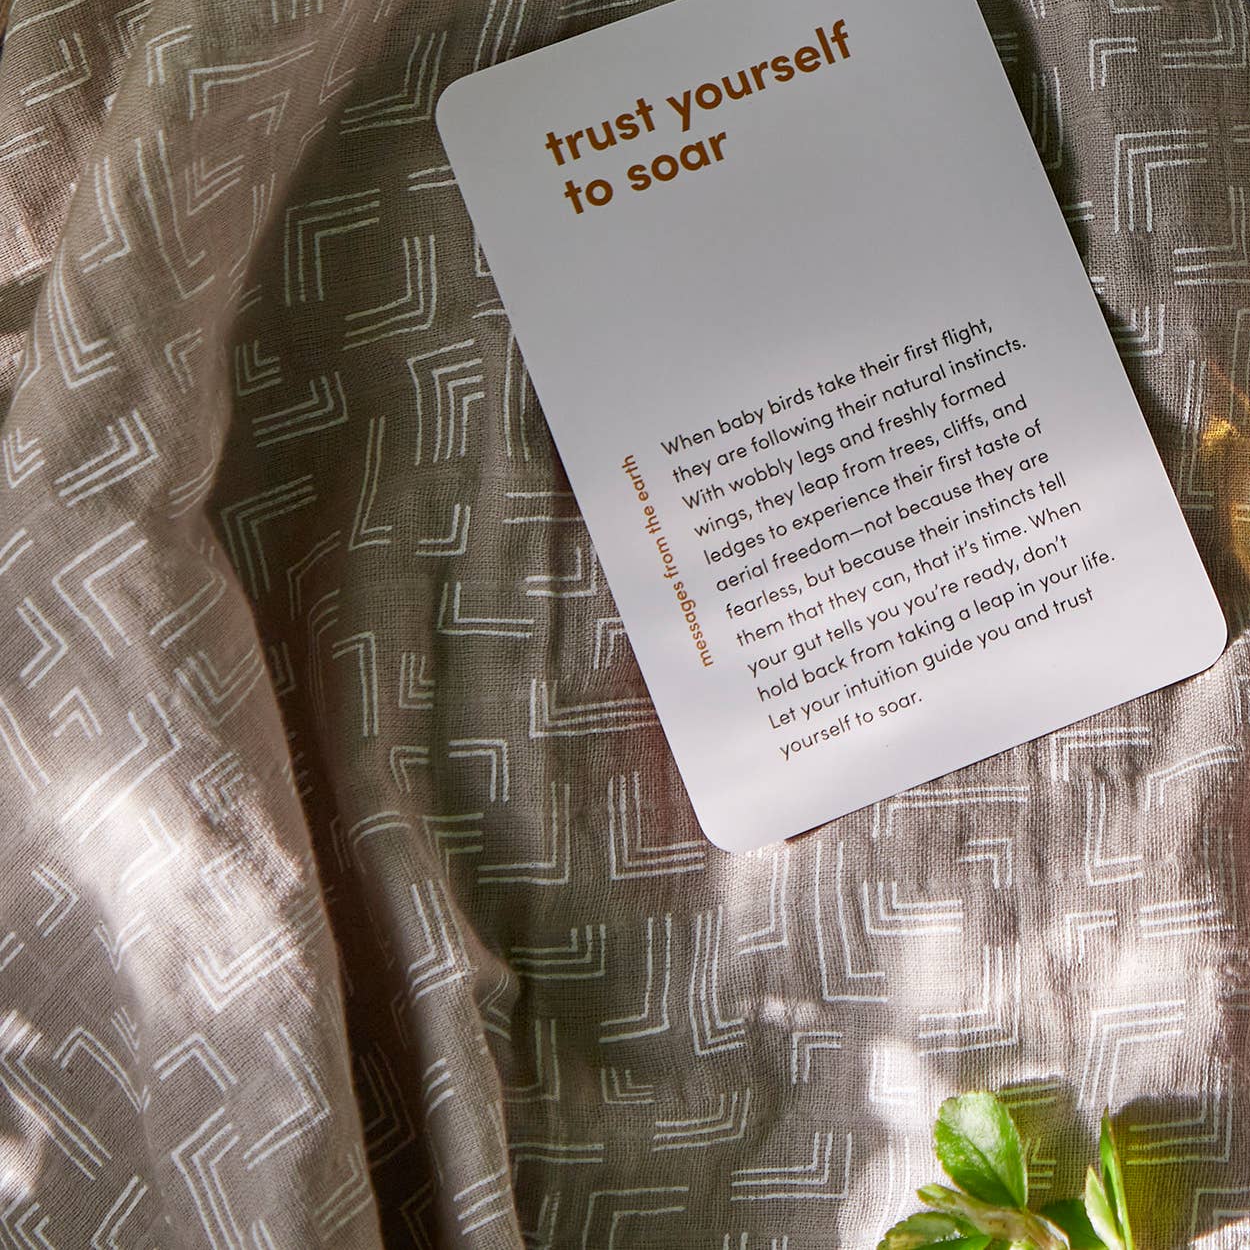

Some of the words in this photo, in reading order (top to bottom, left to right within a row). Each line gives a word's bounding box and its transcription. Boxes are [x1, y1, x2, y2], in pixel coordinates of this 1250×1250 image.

[544, 97, 656, 167] trust
[665, 18, 852, 133] yourself
[563, 178, 614, 215] to
[626, 131, 727, 192] soar
[659, 428, 716, 456] When
[716, 407, 764, 435] baby
[766, 387, 815, 415] birds
[816, 373, 857, 396] take
[858, 353, 900, 380] their
[903, 337, 939, 362] first
[940, 318, 993, 348] flight,
[672, 458, 711, 484] they
[716, 446, 748, 467] are
[750, 412, 835, 453] following
[835, 393, 877, 420] their
[881, 363, 947, 402] natural
[947, 338, 1027, 376] instincts.
[681, 483, 726, 510] With
[727, 457, 793, 493] wobbly
[796, 442, 836, 466] legs
[839, 422, 876, 450] and
[877, 401, 937, 434] freshly
[940, 370, 1007, 410] formed
[621, 454, 650, 502] earth
[643, 505, 662, 535] the
[693, 508, 753, 537] wings,
[754, 489, 794, 514] they
[796, 472, 839, 497] leap
[841, 454, 887, 479] from
[888, 434, 940, 461] trees,
[942, 413, 989, 440] cliffs,
[992, 393, 1028, 420] and
[703, 533, 766, 566] ledges
[767, 524, 788, 540] to
[791, 484, 891, 531] experience
[892, 463, 934, 491] their
[937, 447, 973, 473] first
[975, 432, 1021, 458] taste
[1024, 417, 1042, 439] of
[655, 536, 680, 580] from
[725, 583, 803, 620] fearless,
[803, 564, 836, 588] but
[838, 536, 916, 575] because
[918, 516, 960, 543] their
[962, 488, 1037, 525] instincts
[1038, 470, 1067, 495] tell
[673, 580, 714, 668] messages
[767, 706, 797, 730] Let
[800, 691, 841, 721] your
[843, 661, 919, 699] intuition
[922, 638, 974, 672] guide
[976, 623, 1011, 650] you
[1014, 602, 1050, 630] and
[1052, 586, 1094, 615] trust
[779, 713, 851, 761] yourself
[854, 711, 874, 727] to
[878, 692, 923, 718] soar.
